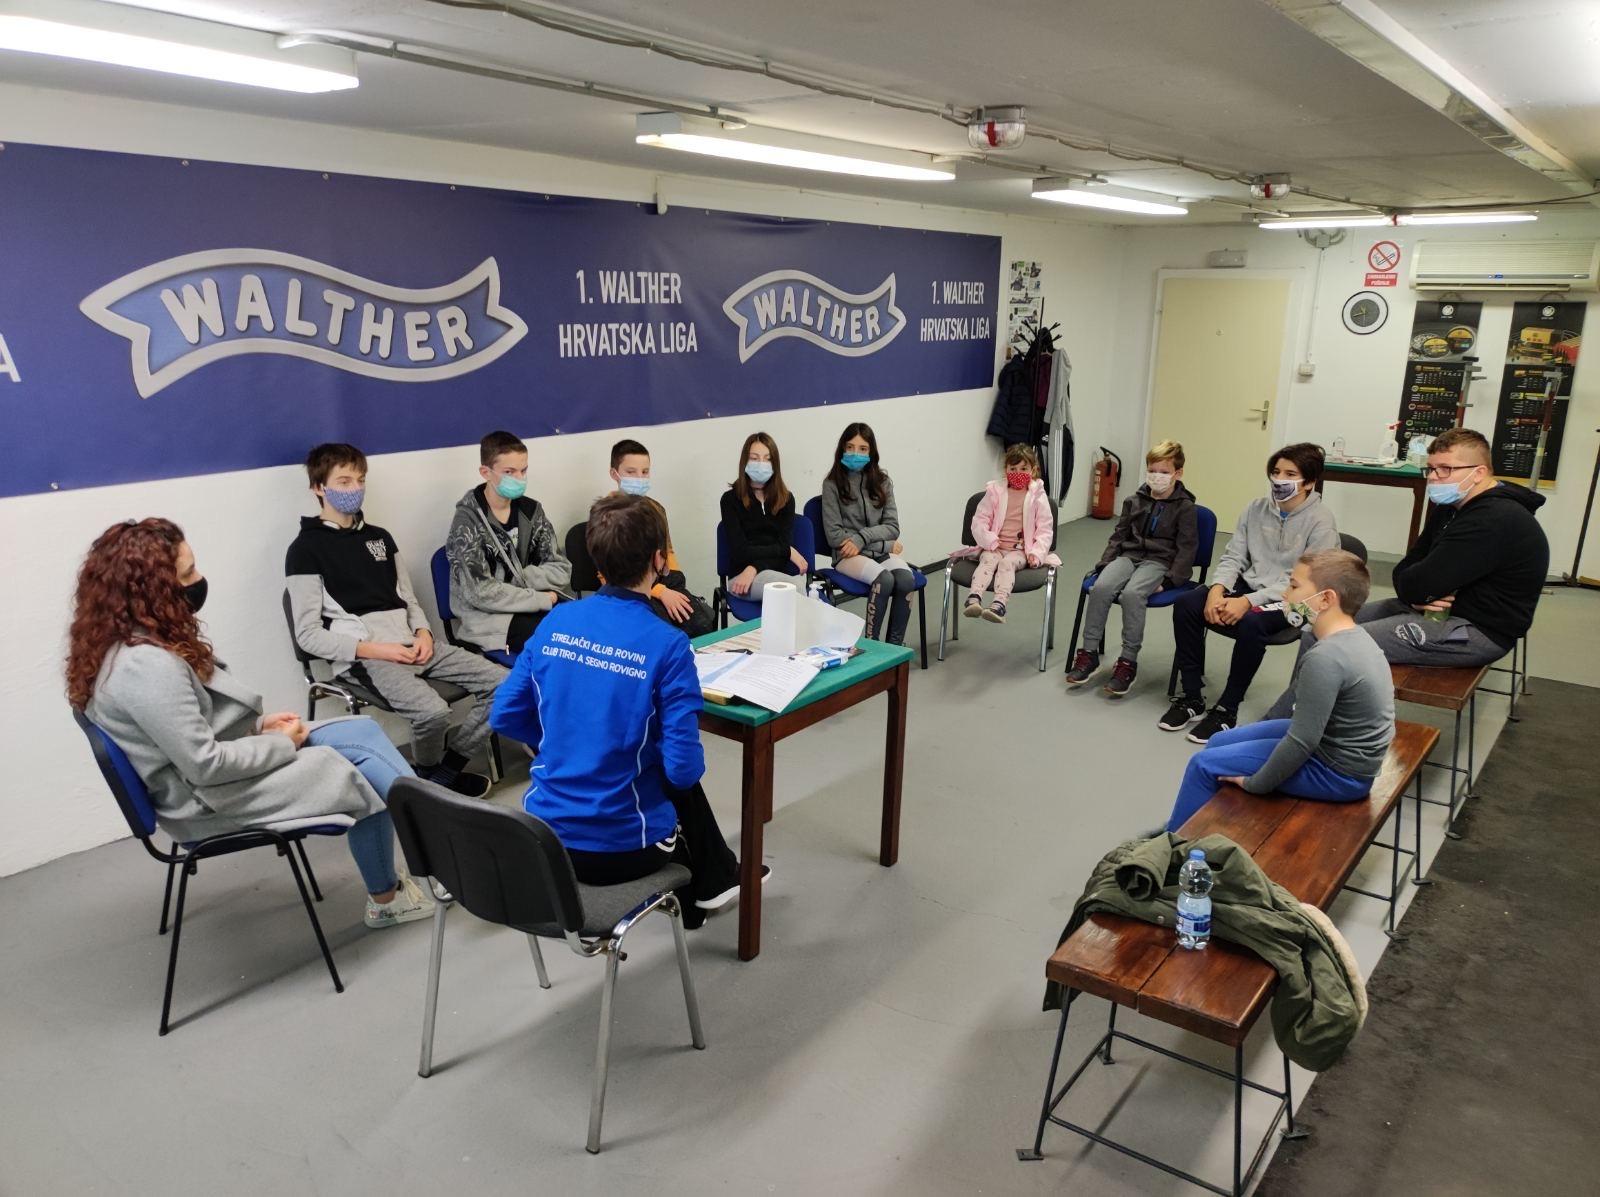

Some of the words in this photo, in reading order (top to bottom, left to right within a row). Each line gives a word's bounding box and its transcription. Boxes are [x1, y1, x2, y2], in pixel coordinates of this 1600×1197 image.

[576, 269, 594, 304] 1.
[598, 270, 682, 304] WALTHER
[931, 281, 940, 305] 1.
[943, 281, 985, 305] WALTHER
[160, 274, 474, 361] WALTHER
[753, 286, 881, 343] WALTHER
[920, 317, 969, 342] HRVATSKA
[970, 316, 990, 340] LIGA
[558, 322, 657, 358] HRVATSKA
[660, 321, 698, 354] LIGA
[542, 645, 558, 657] CLUB
[559, 648, 576, 661] TIRO
[577, 654, 584, 664] A
[585, 656, 608, 670] SEGNO
[609, 662, 647, 680] ROVIGNO
[551, 632, 590, 650] STRELJAČKI
[591, 643, 613, 656] KLUB
[614, 648, 646, 665] ROVINJ
